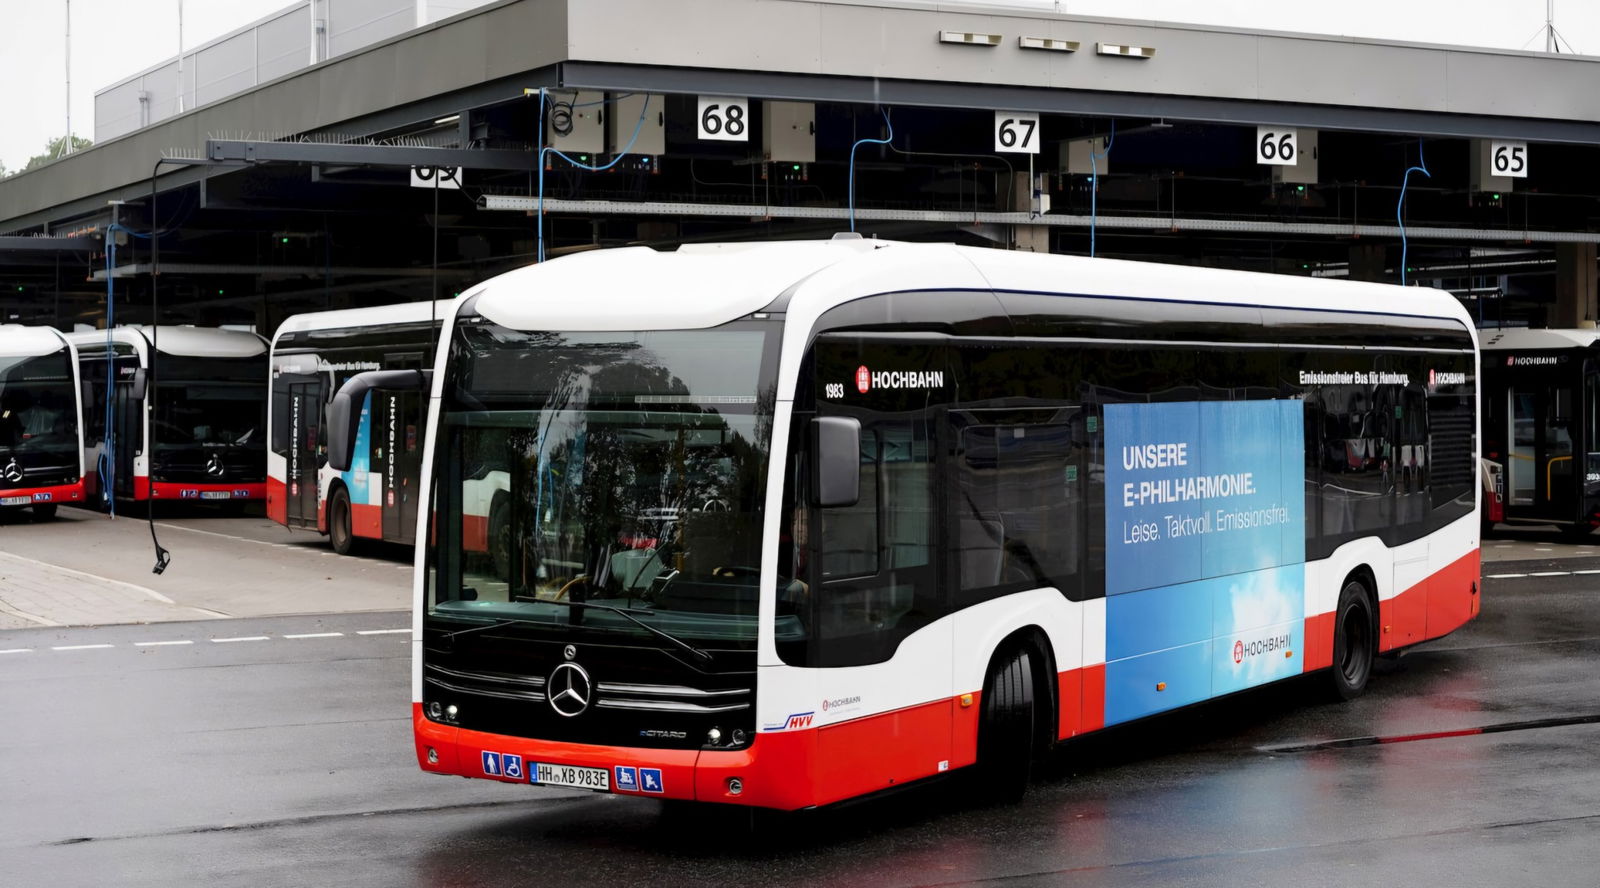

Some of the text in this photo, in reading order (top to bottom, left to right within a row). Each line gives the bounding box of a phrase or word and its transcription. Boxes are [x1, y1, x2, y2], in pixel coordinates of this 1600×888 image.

[702, 104, 745, 137] 68
[998, 119, 1038, 149] 67
[1258, 132, 1295, 162] 66
[1493, 147, 1526, 174] 65
[825, 383, 844, 399] 1983
[871, 370, 944, 389] HOCHBAHN
[1299, 370, 1353, 385] Emissionsfreier
[1355, 370, 1369, 385] Bus
[1379, 370, 1410, 388] Hamburg.
[388, 396, 396, 488] HOCHBAHN
[1122, 442, 1188, 471] UNSERE
[1123, 472, 1256, 508] E-PHILHARMONIE.
[1123, 503, 1290, 545] Leise. Taktvoll. Emissionsfrei.
[1243, 633, 1292, 658] HOCHBAHN
[828, 695, 861, 709] HOCHBAHN
[789, 714, 814, 729] HVV
[537, 765, 553, 782] HH
[561, 767, 576, 784] XB
[578, 769, 607, 787] 983E
